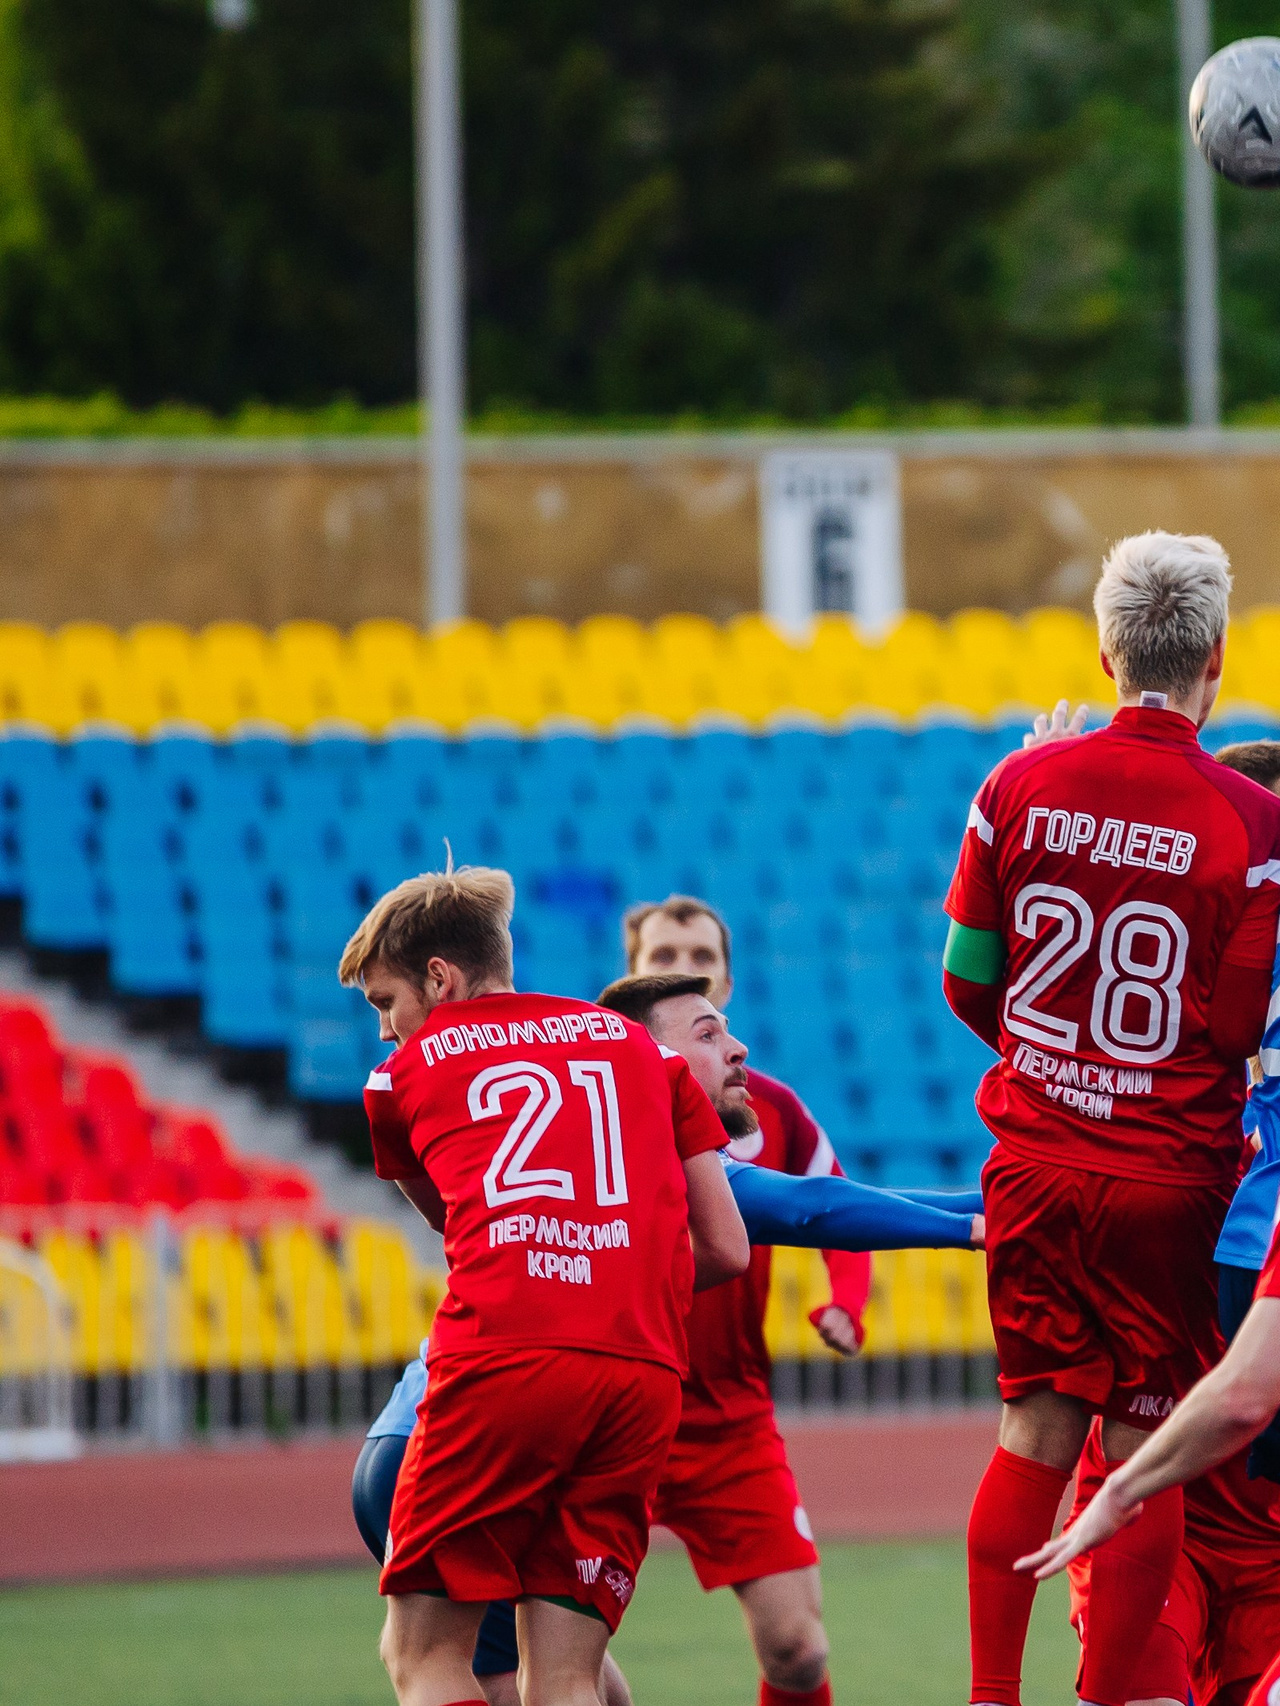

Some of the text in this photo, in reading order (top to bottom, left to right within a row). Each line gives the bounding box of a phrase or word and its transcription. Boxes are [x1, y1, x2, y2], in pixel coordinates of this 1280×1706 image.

[1023, 806, 1197, 875] ГОРДЕЕВ
[1003, 883, 1189, 1064] 28
[420, 1012, 628, 1067] ПОНОМАРЕВ
[467, 1060, 629, 1209] 21
[489, 1214, 629, 1251] ПЕРМСКИЙ
[527, 1250, 592, 1285] КРАЙ
